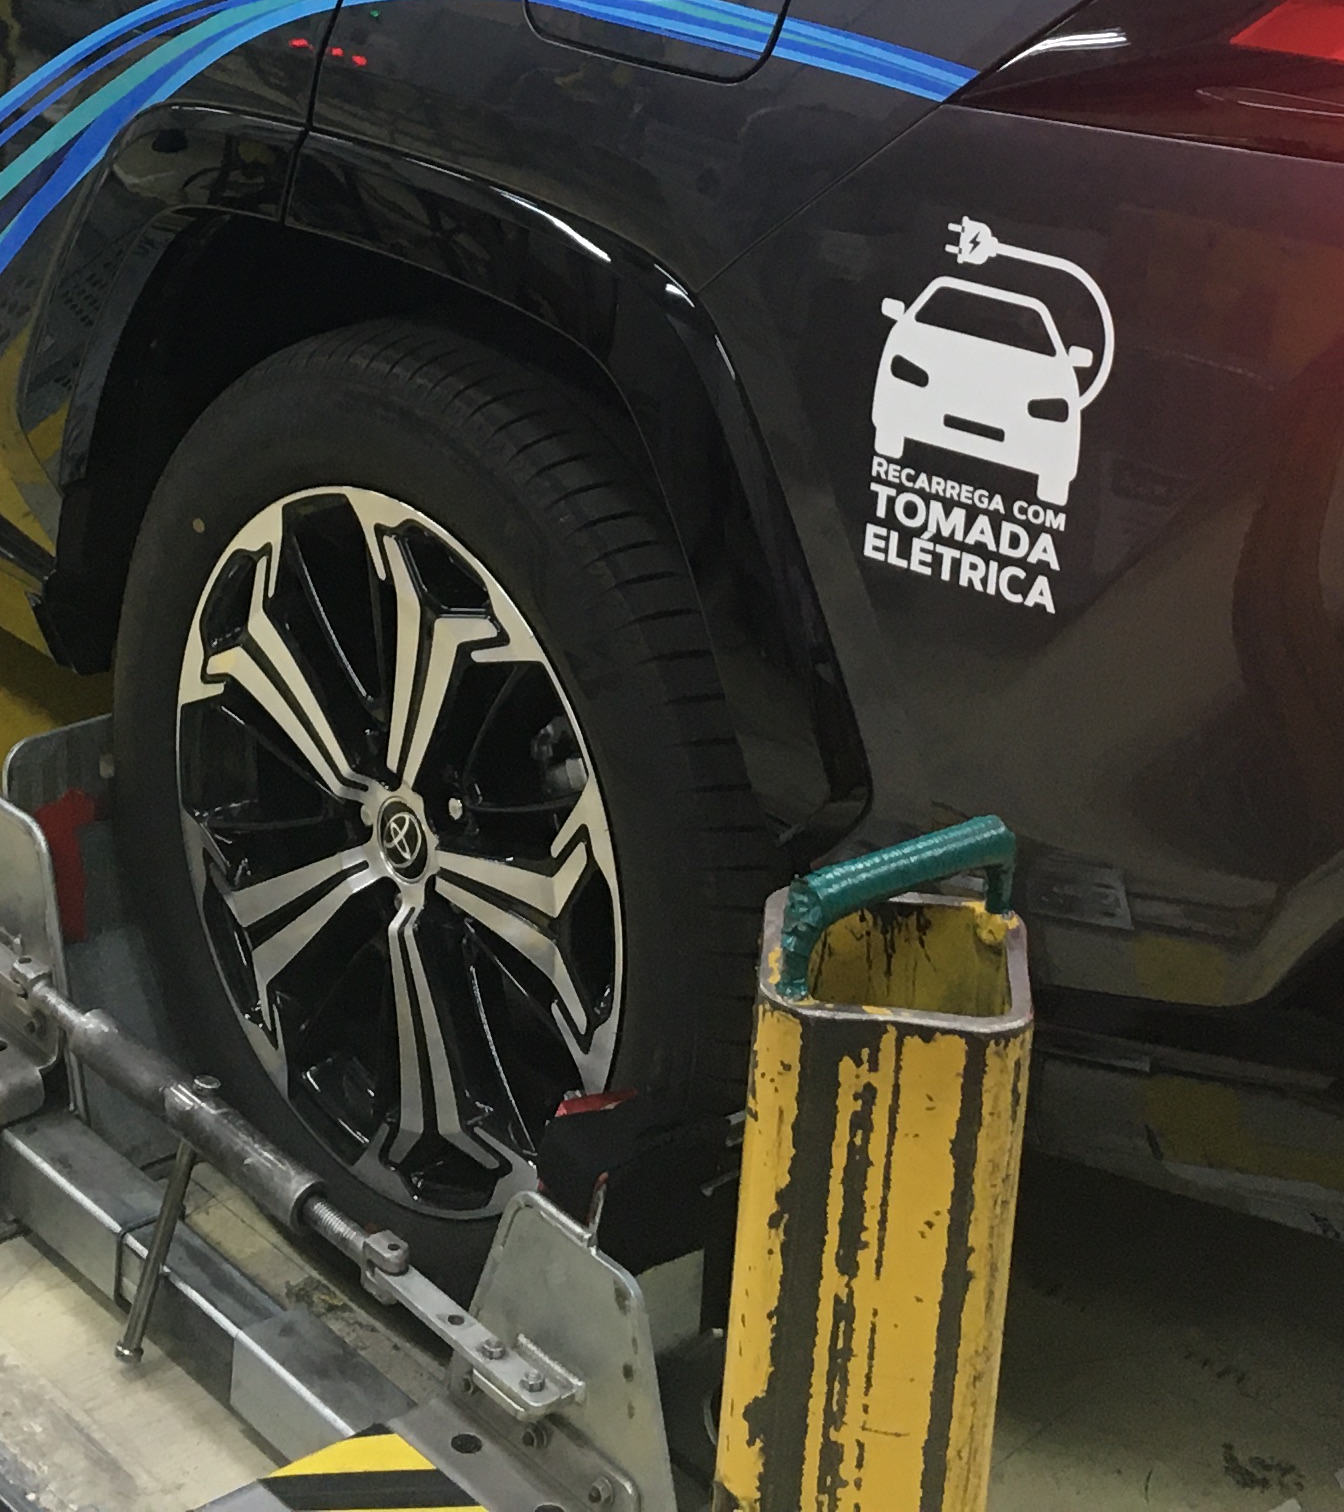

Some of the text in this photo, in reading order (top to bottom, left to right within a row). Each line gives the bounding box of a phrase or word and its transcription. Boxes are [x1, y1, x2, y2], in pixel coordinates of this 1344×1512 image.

[870, 482, 1060, 571] TOMADA
[872, 455, 1067, 532] RECARREGA COM
[863, 520, 1056, 614] ELÉTRICA
